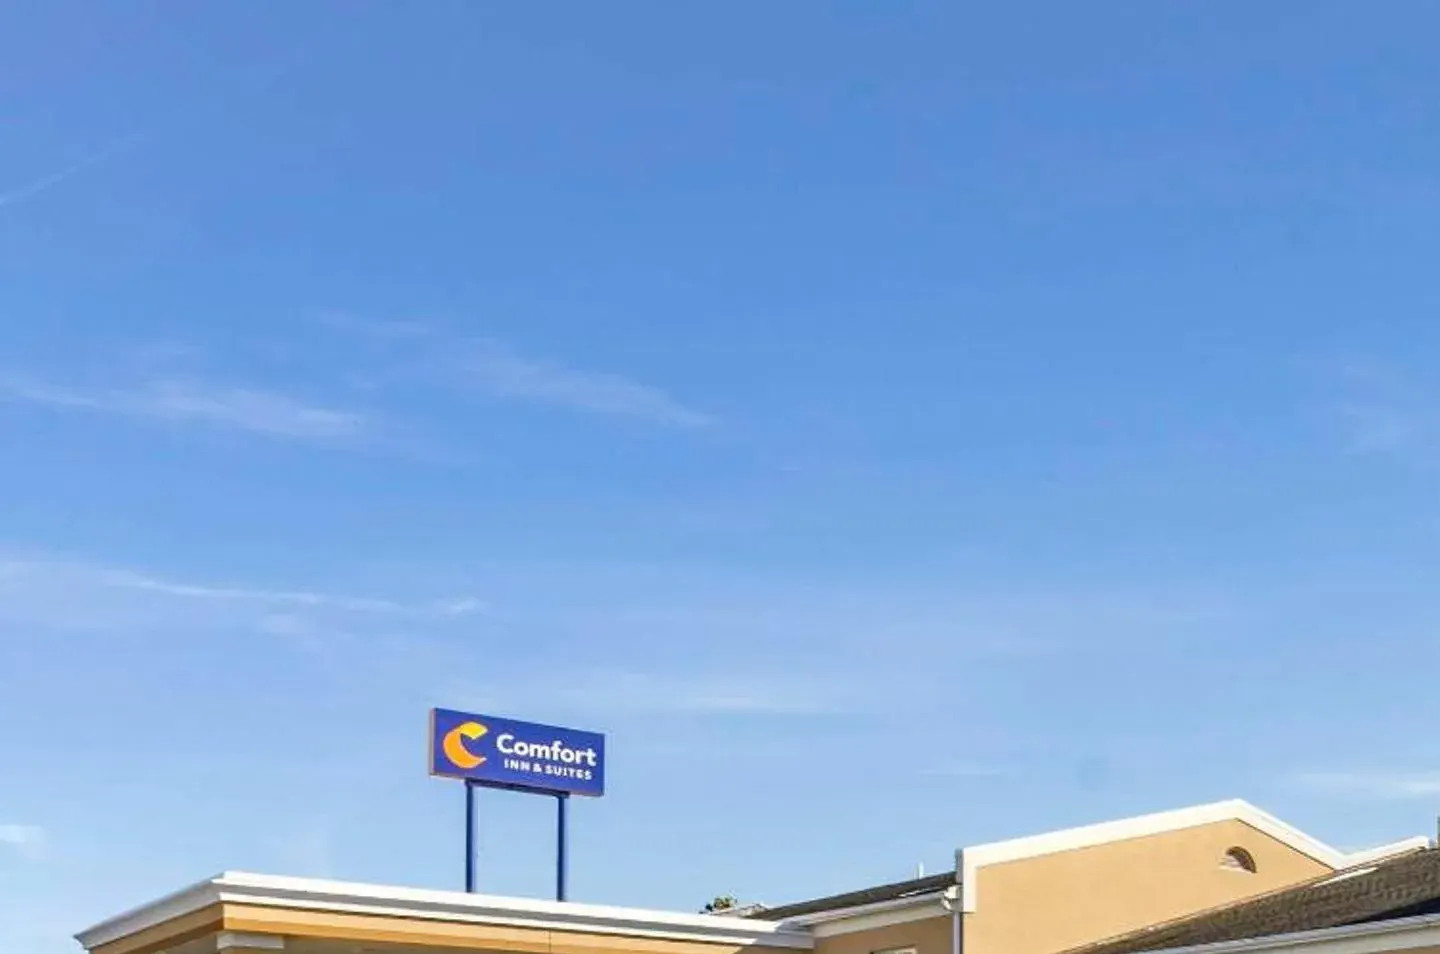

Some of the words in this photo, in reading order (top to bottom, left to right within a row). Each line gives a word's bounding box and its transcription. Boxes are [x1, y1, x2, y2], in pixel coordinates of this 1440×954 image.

[496, 733, 597, 767] Comfort
[504, 758, 530, 772] INN
[532, 762, 543, 774] &
[544, 765, 593, 780] SUITES
